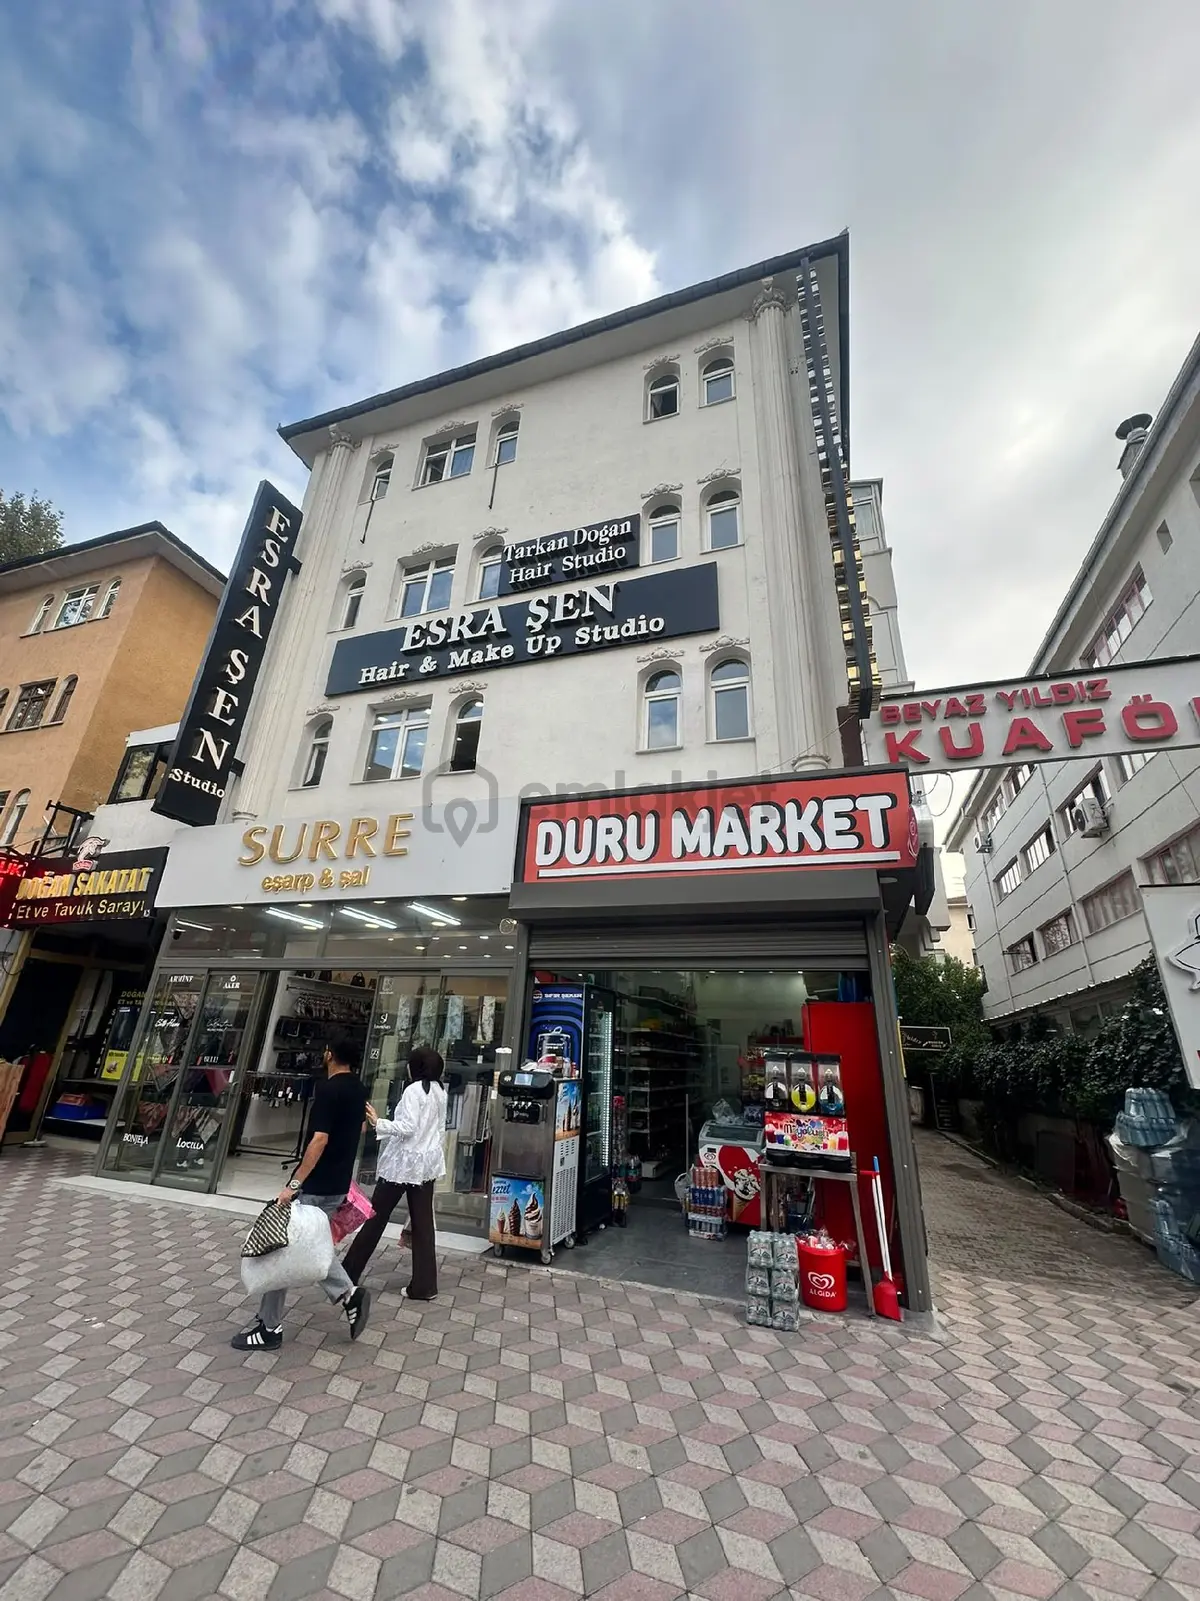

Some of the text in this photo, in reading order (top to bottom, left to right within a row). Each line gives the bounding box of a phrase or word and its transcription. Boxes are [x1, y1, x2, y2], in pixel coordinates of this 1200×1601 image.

[503, 536, 569, 562] Tarkan
[509, 545, 626, 583] Hair Studio
[400, 581, 619, 652] ESRA ŞEN
[191, 505, 290, 771] ESRA ŞEN
[358, 614, 665, 685] Hair & Make Up Studio
[881, 678, 1112, 725] BEYAZ YILDIZ
[168, 768, 225, 798] Studio
[237, 813, 416, 867] SURRE
[535, 793, 896, 867] DURU MARKET
[16, 867, 154, 900] DOĞAN SAKATAT
[261, 863, 371, 895] eşarp & şal
[16, 899, 145, 919] Et ve Tavuk Sarayı
